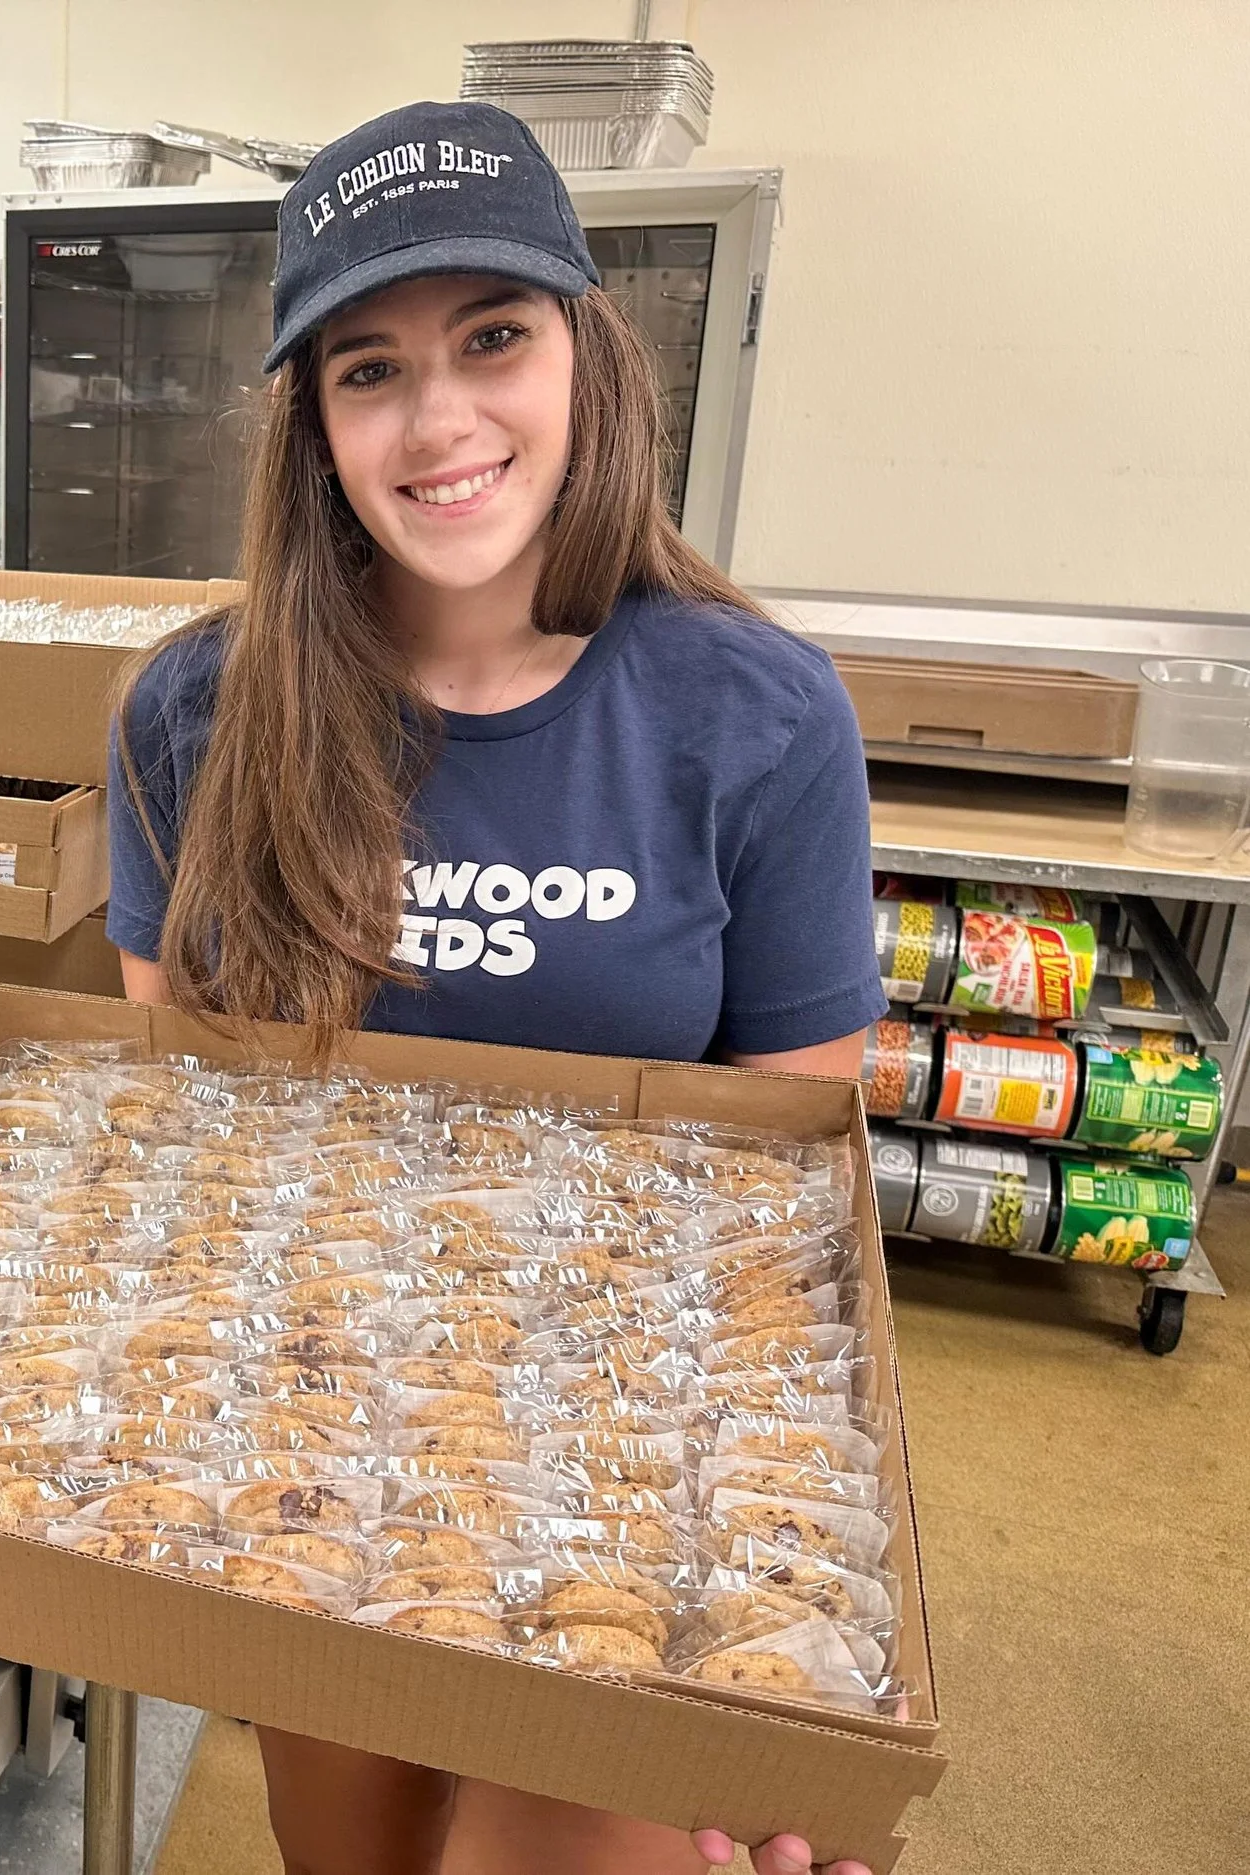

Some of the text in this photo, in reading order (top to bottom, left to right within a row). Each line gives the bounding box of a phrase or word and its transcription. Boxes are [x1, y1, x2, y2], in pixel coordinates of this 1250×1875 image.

[304, 139, 501, 238] LE CORDON BLEU
[351, 178, 461, 220] EST. 1895 PARIS
